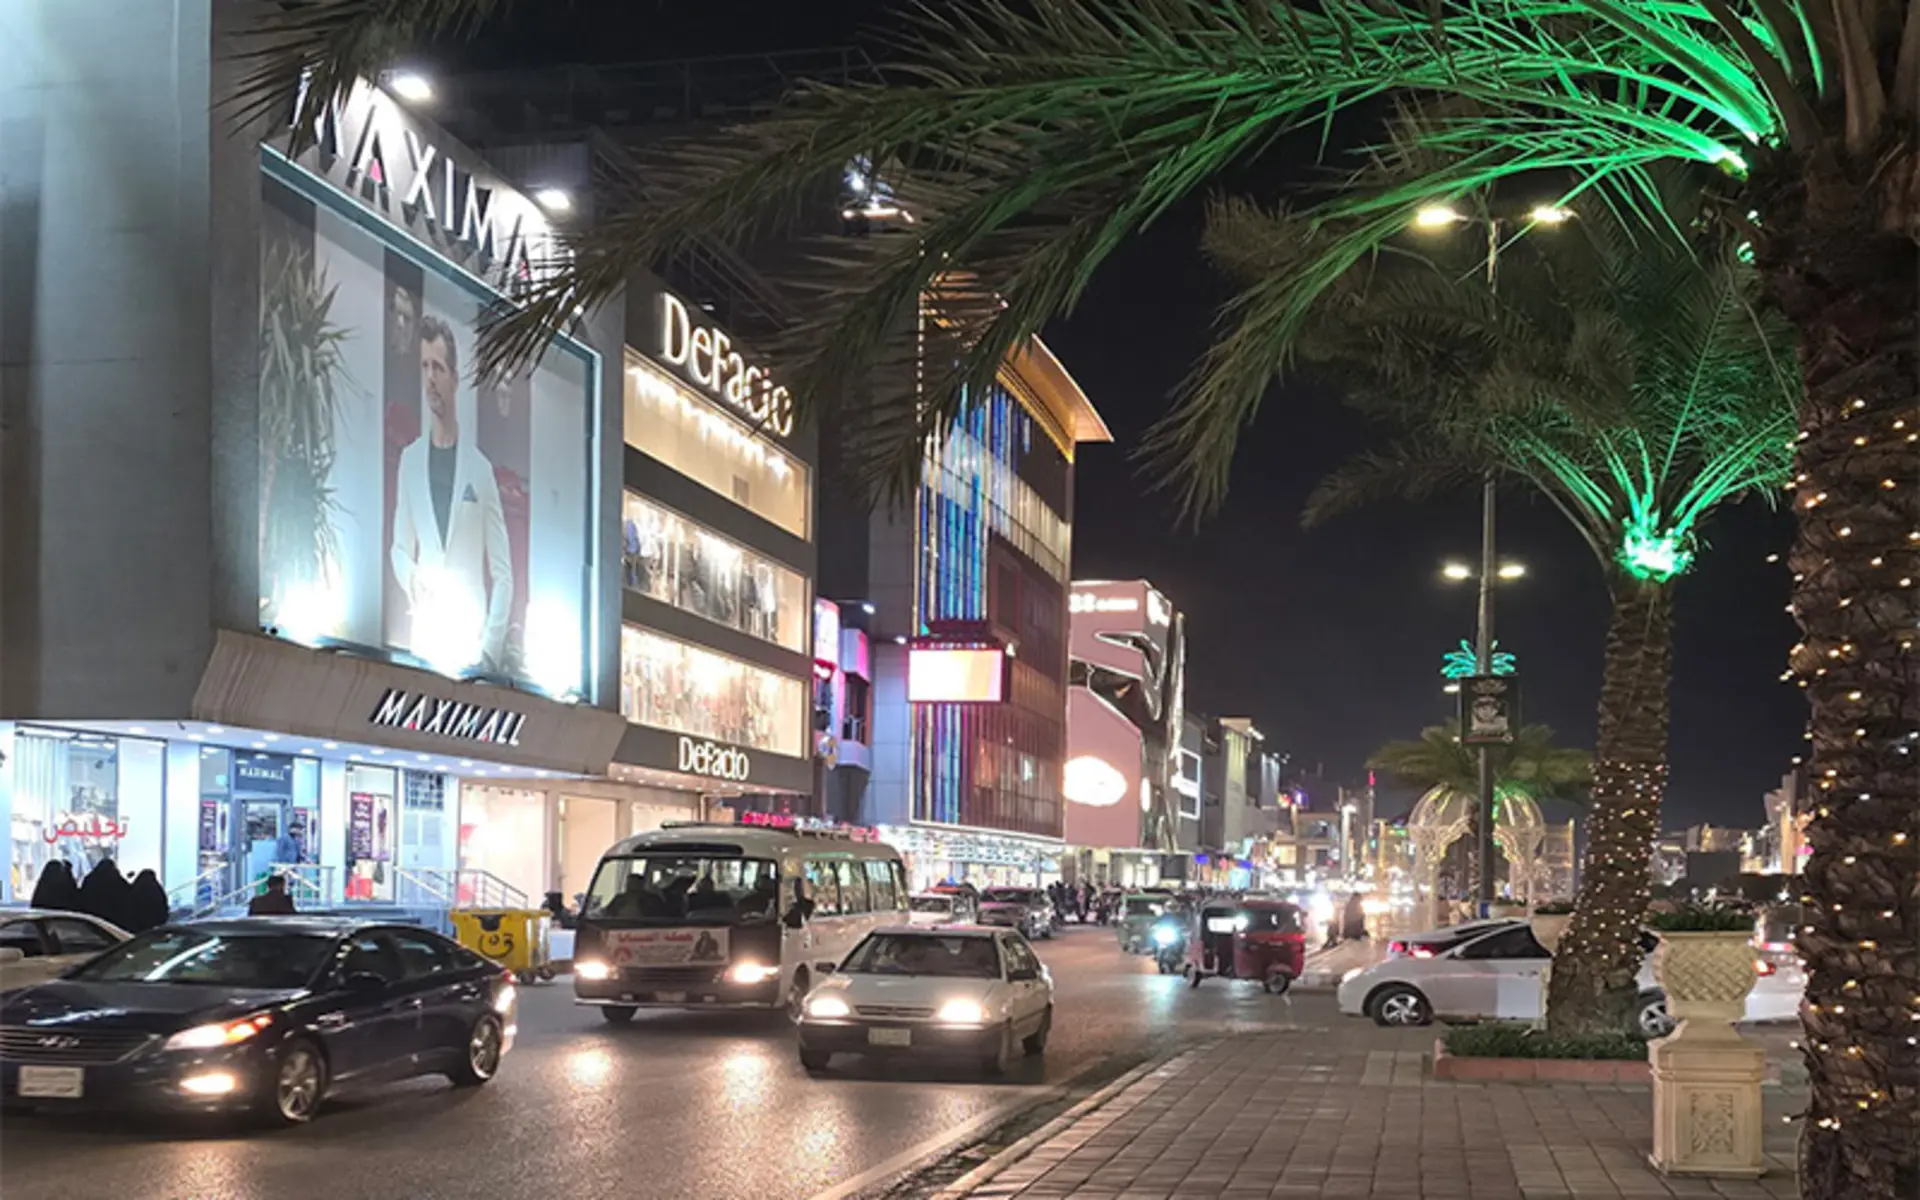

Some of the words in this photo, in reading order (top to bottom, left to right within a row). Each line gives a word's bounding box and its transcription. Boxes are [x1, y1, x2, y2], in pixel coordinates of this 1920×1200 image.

[370, 688, 527, 747] MAXIMALL
[679, 736, 750, 780] DeFacto
[42, 812, 130, 844] تخفيض
